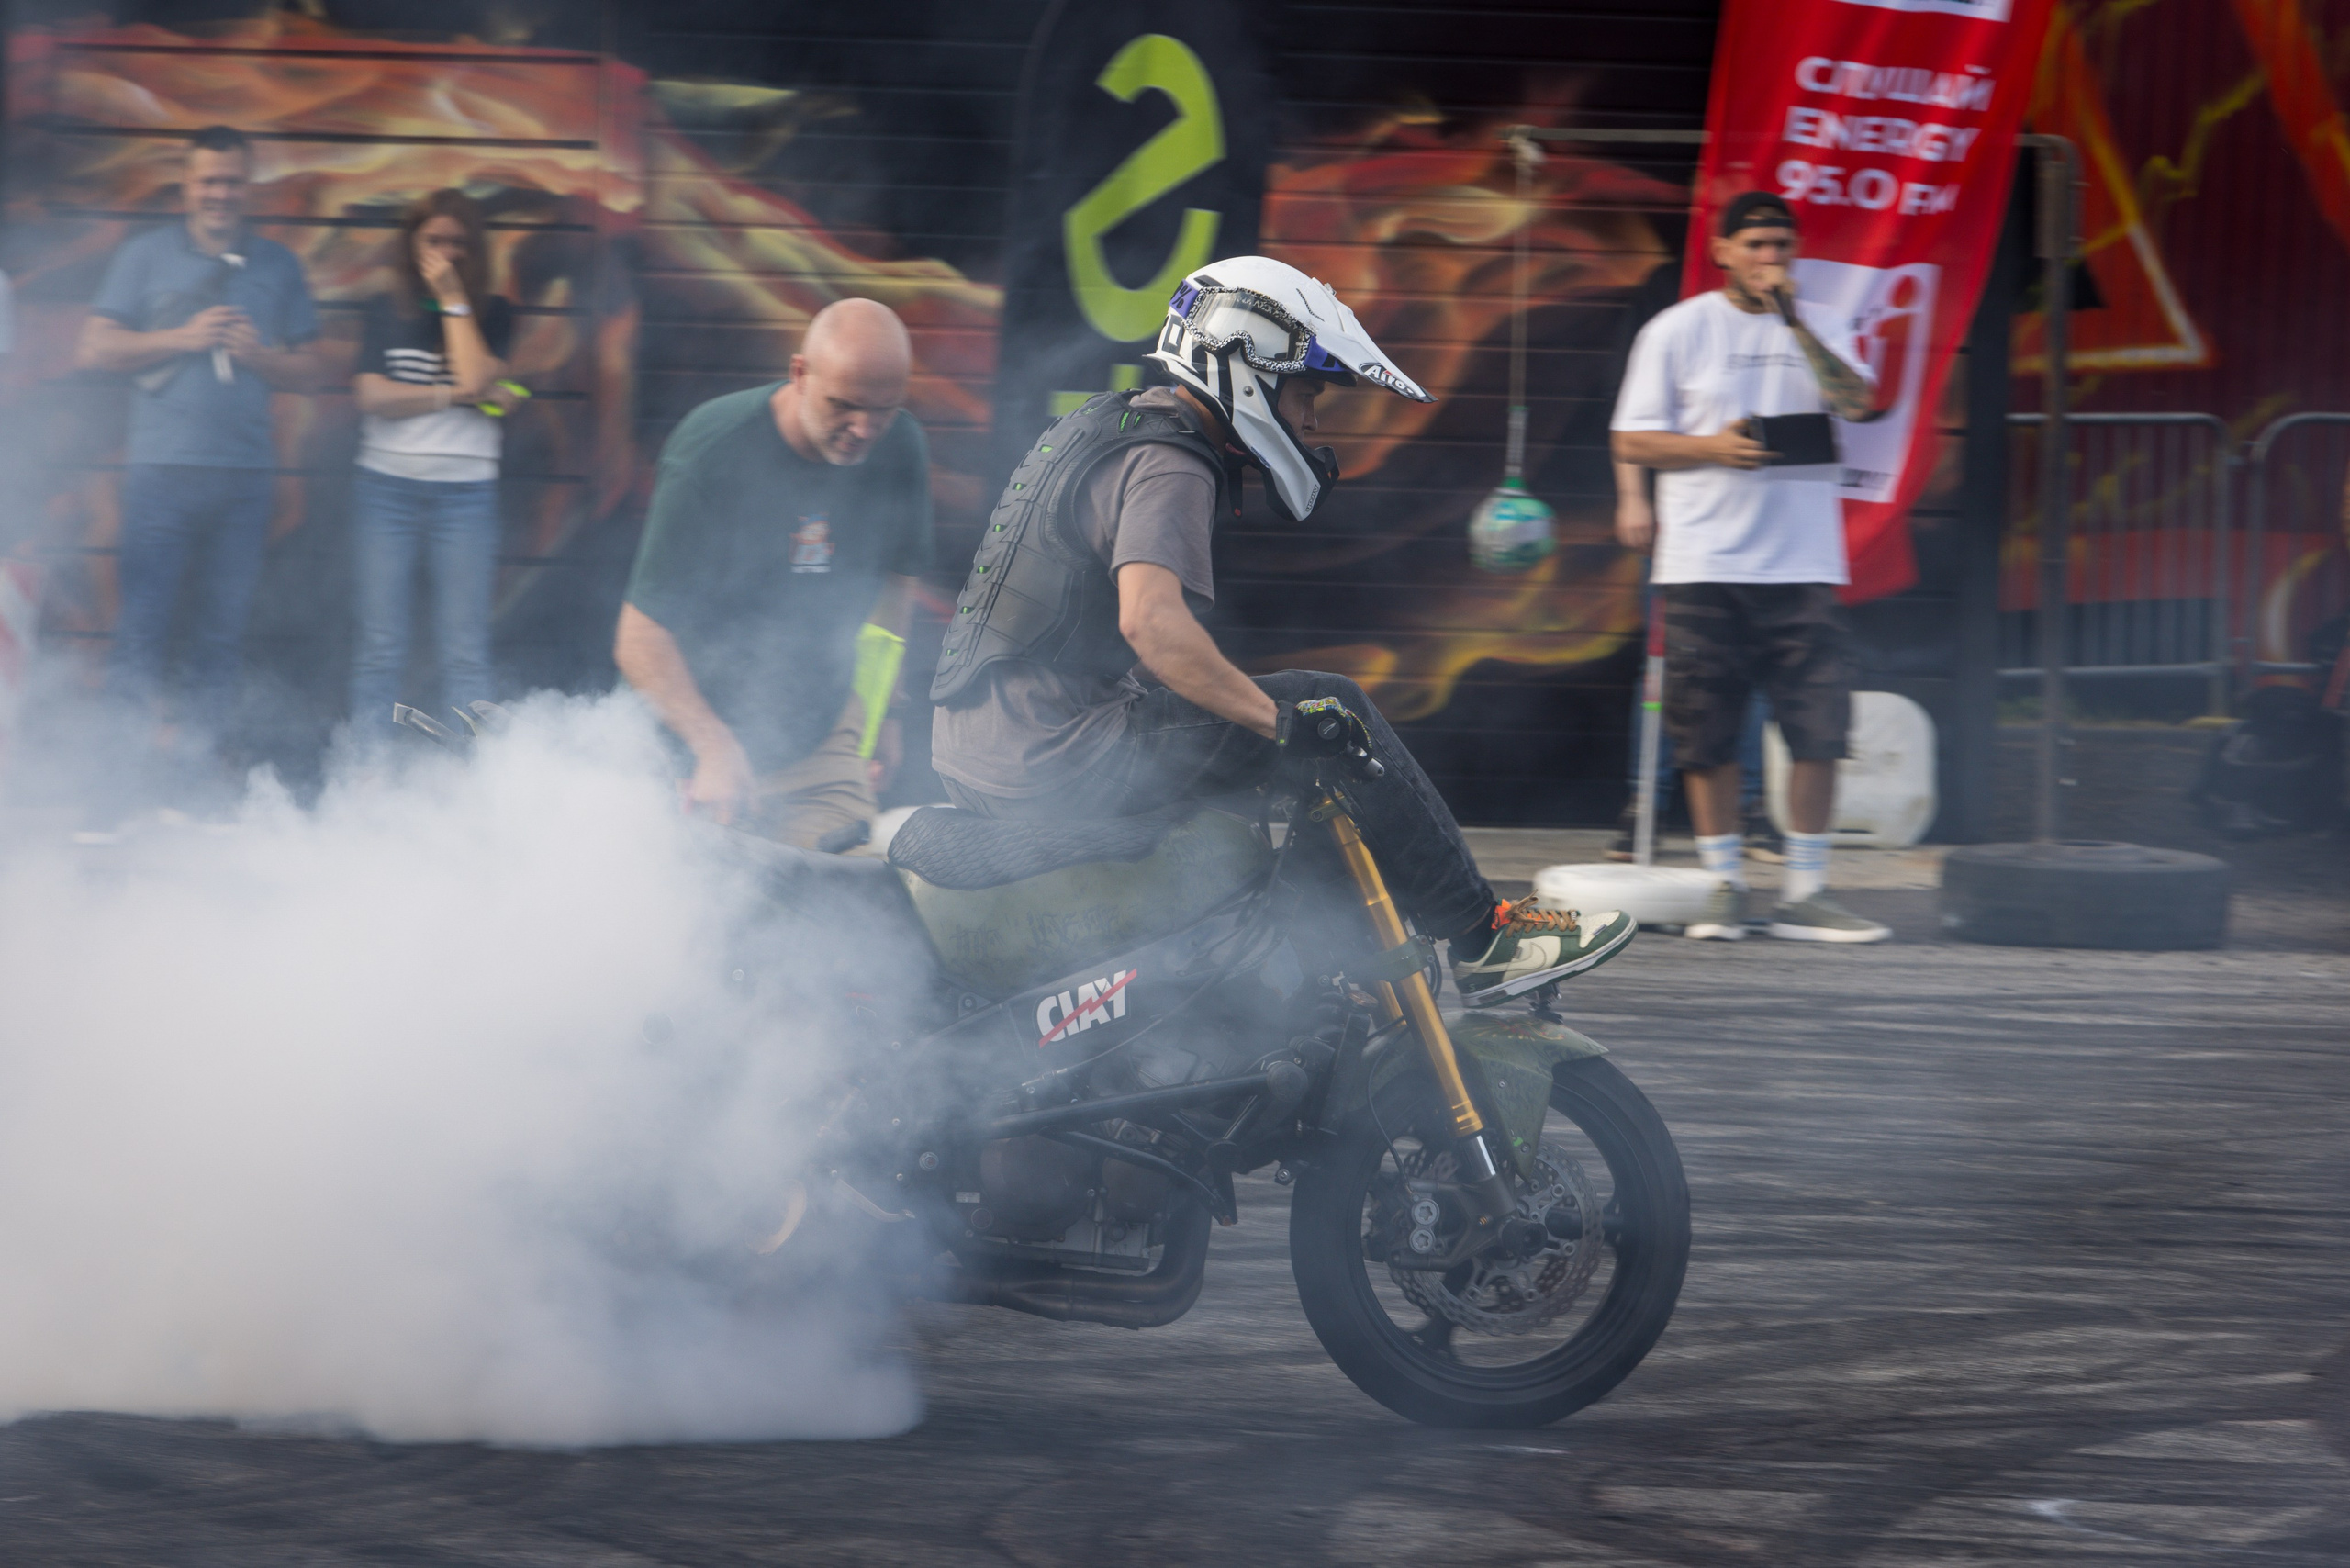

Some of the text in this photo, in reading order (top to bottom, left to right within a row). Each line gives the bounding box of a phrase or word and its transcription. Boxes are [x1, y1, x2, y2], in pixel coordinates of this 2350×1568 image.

[1794, 55, 1996, 111] СЛУШАЙ
[1783, 106, 1982, 162] ENERGY
[1776, 159, 1899, 210] 95.0
